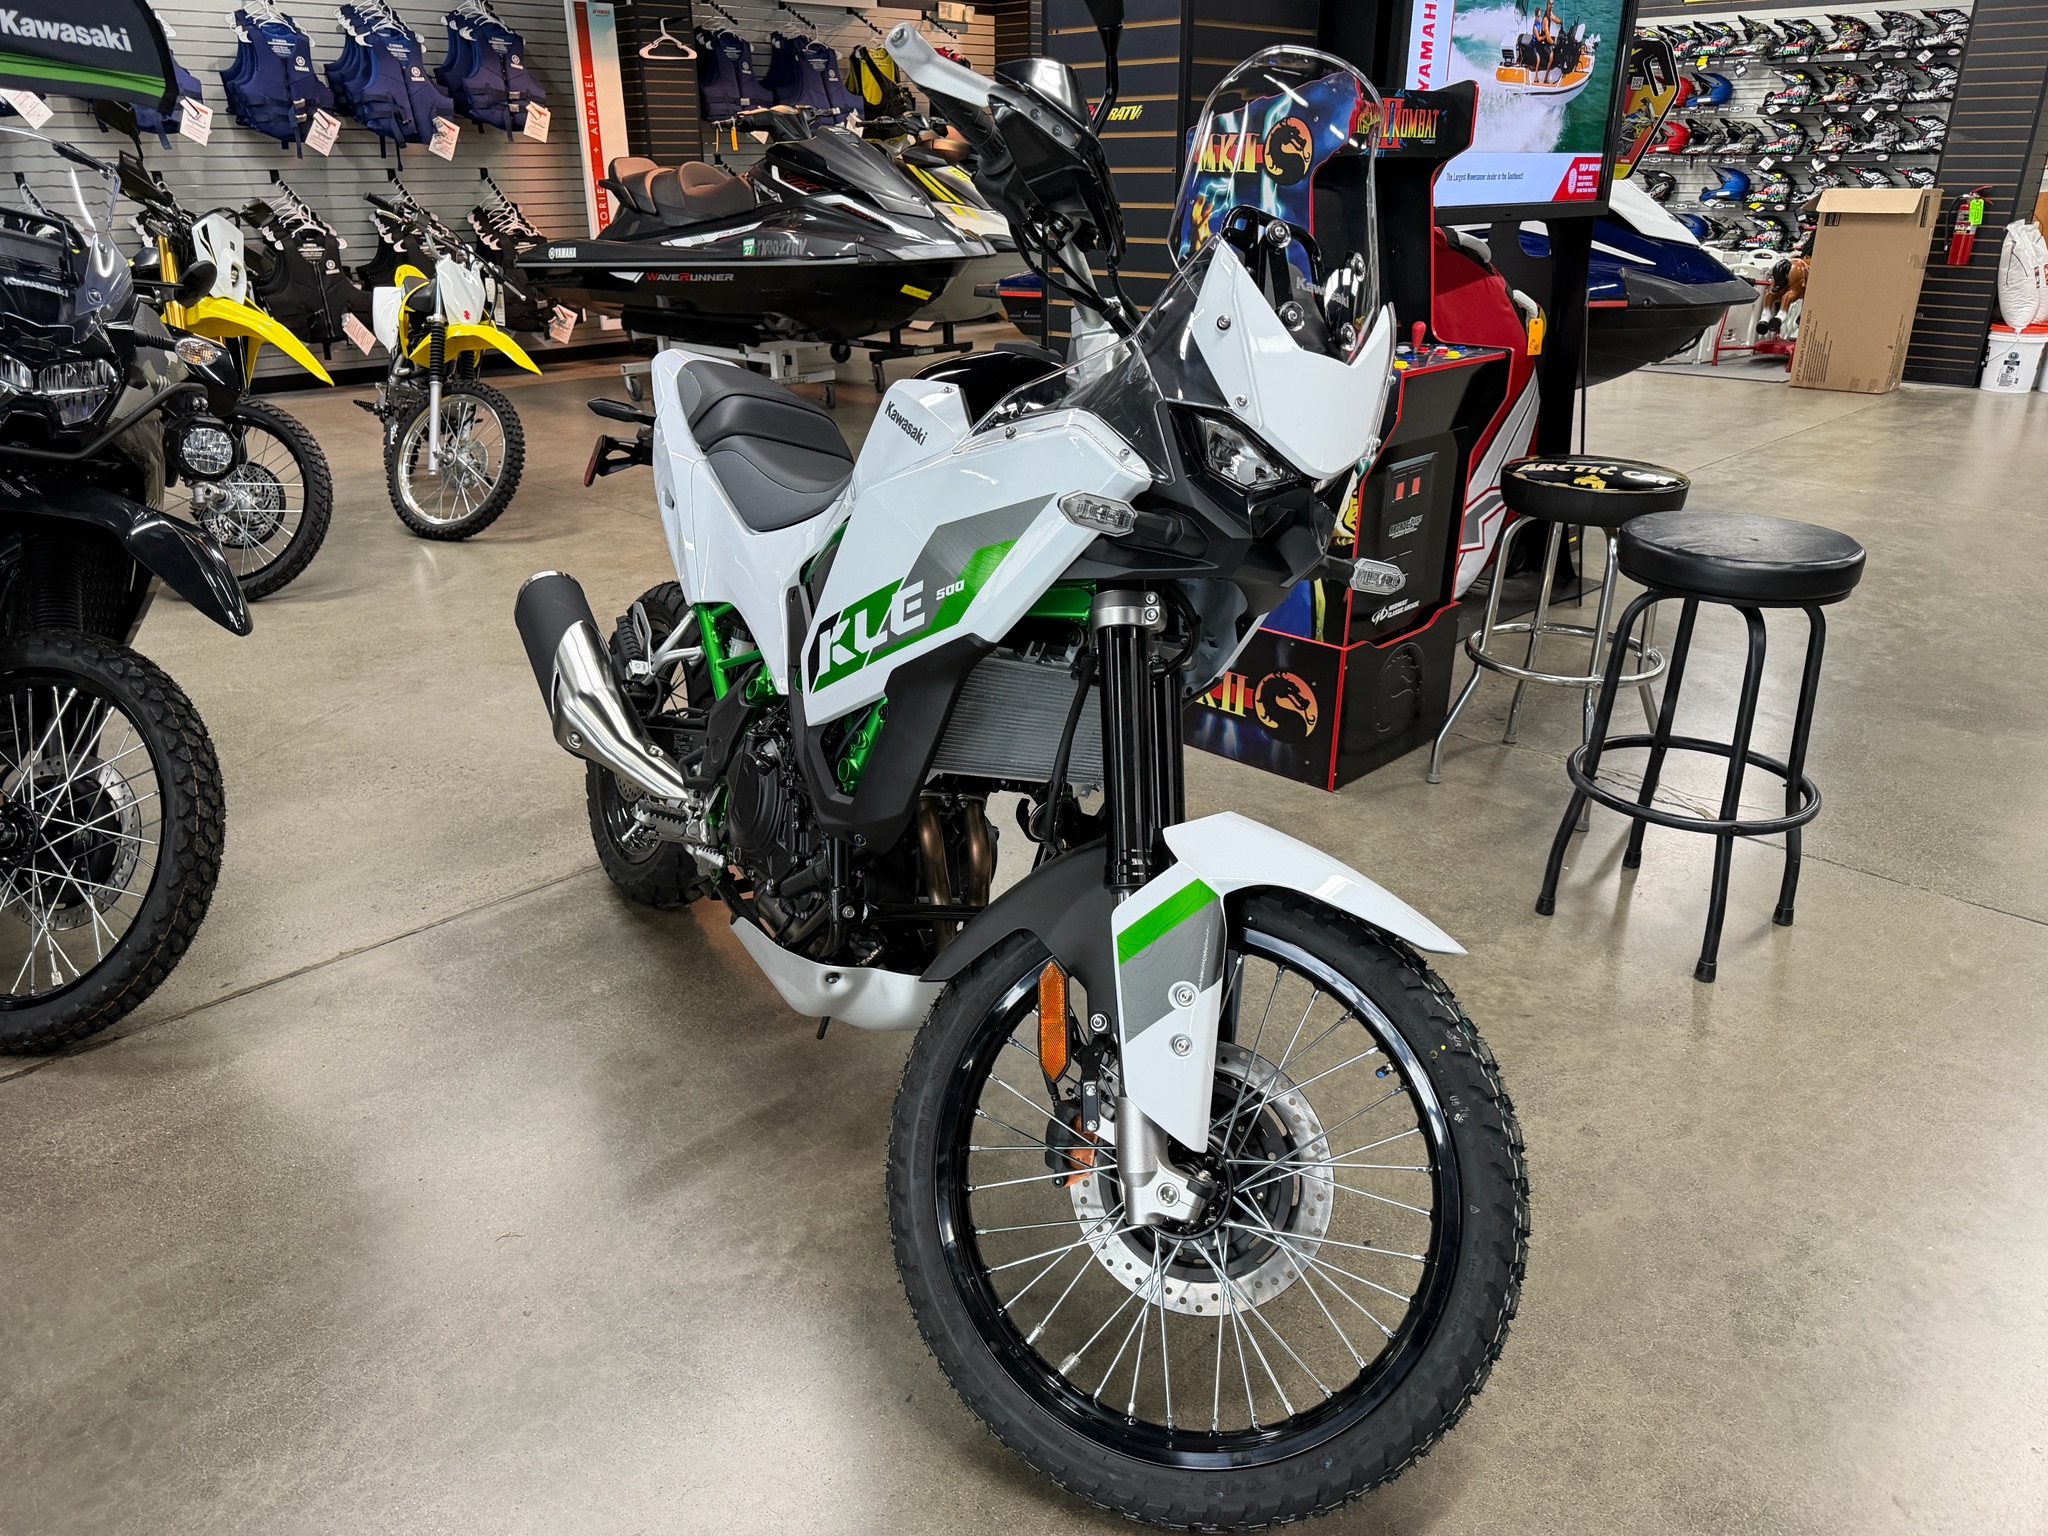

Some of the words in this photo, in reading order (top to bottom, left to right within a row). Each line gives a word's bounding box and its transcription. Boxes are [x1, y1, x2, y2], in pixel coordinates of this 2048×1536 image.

[0, 8, 133, 53] Kawasaki
[1417, 0, 1438, 91] YAMAH
[584, 73, 599, 136] APPAREL
[1393, 107, 1440, 139] KOMBAT
[596, 180, 609, 230] SORIE
[555, 246, 577, 260] YAMAHA
[743, 245, 753, 256] 27
[1296, 276, 1350, 309] Kawsaki
[1805, 309, 1813, 324] BOX
[1801, 325, 1810, 349] CARGO
[884, 400, 929, 447] Kawasaki
[1516, 462, 1620, 476] ARCTIC
[818, 579, 926, 678] KLE
[935, 579, 965, 601] 500
